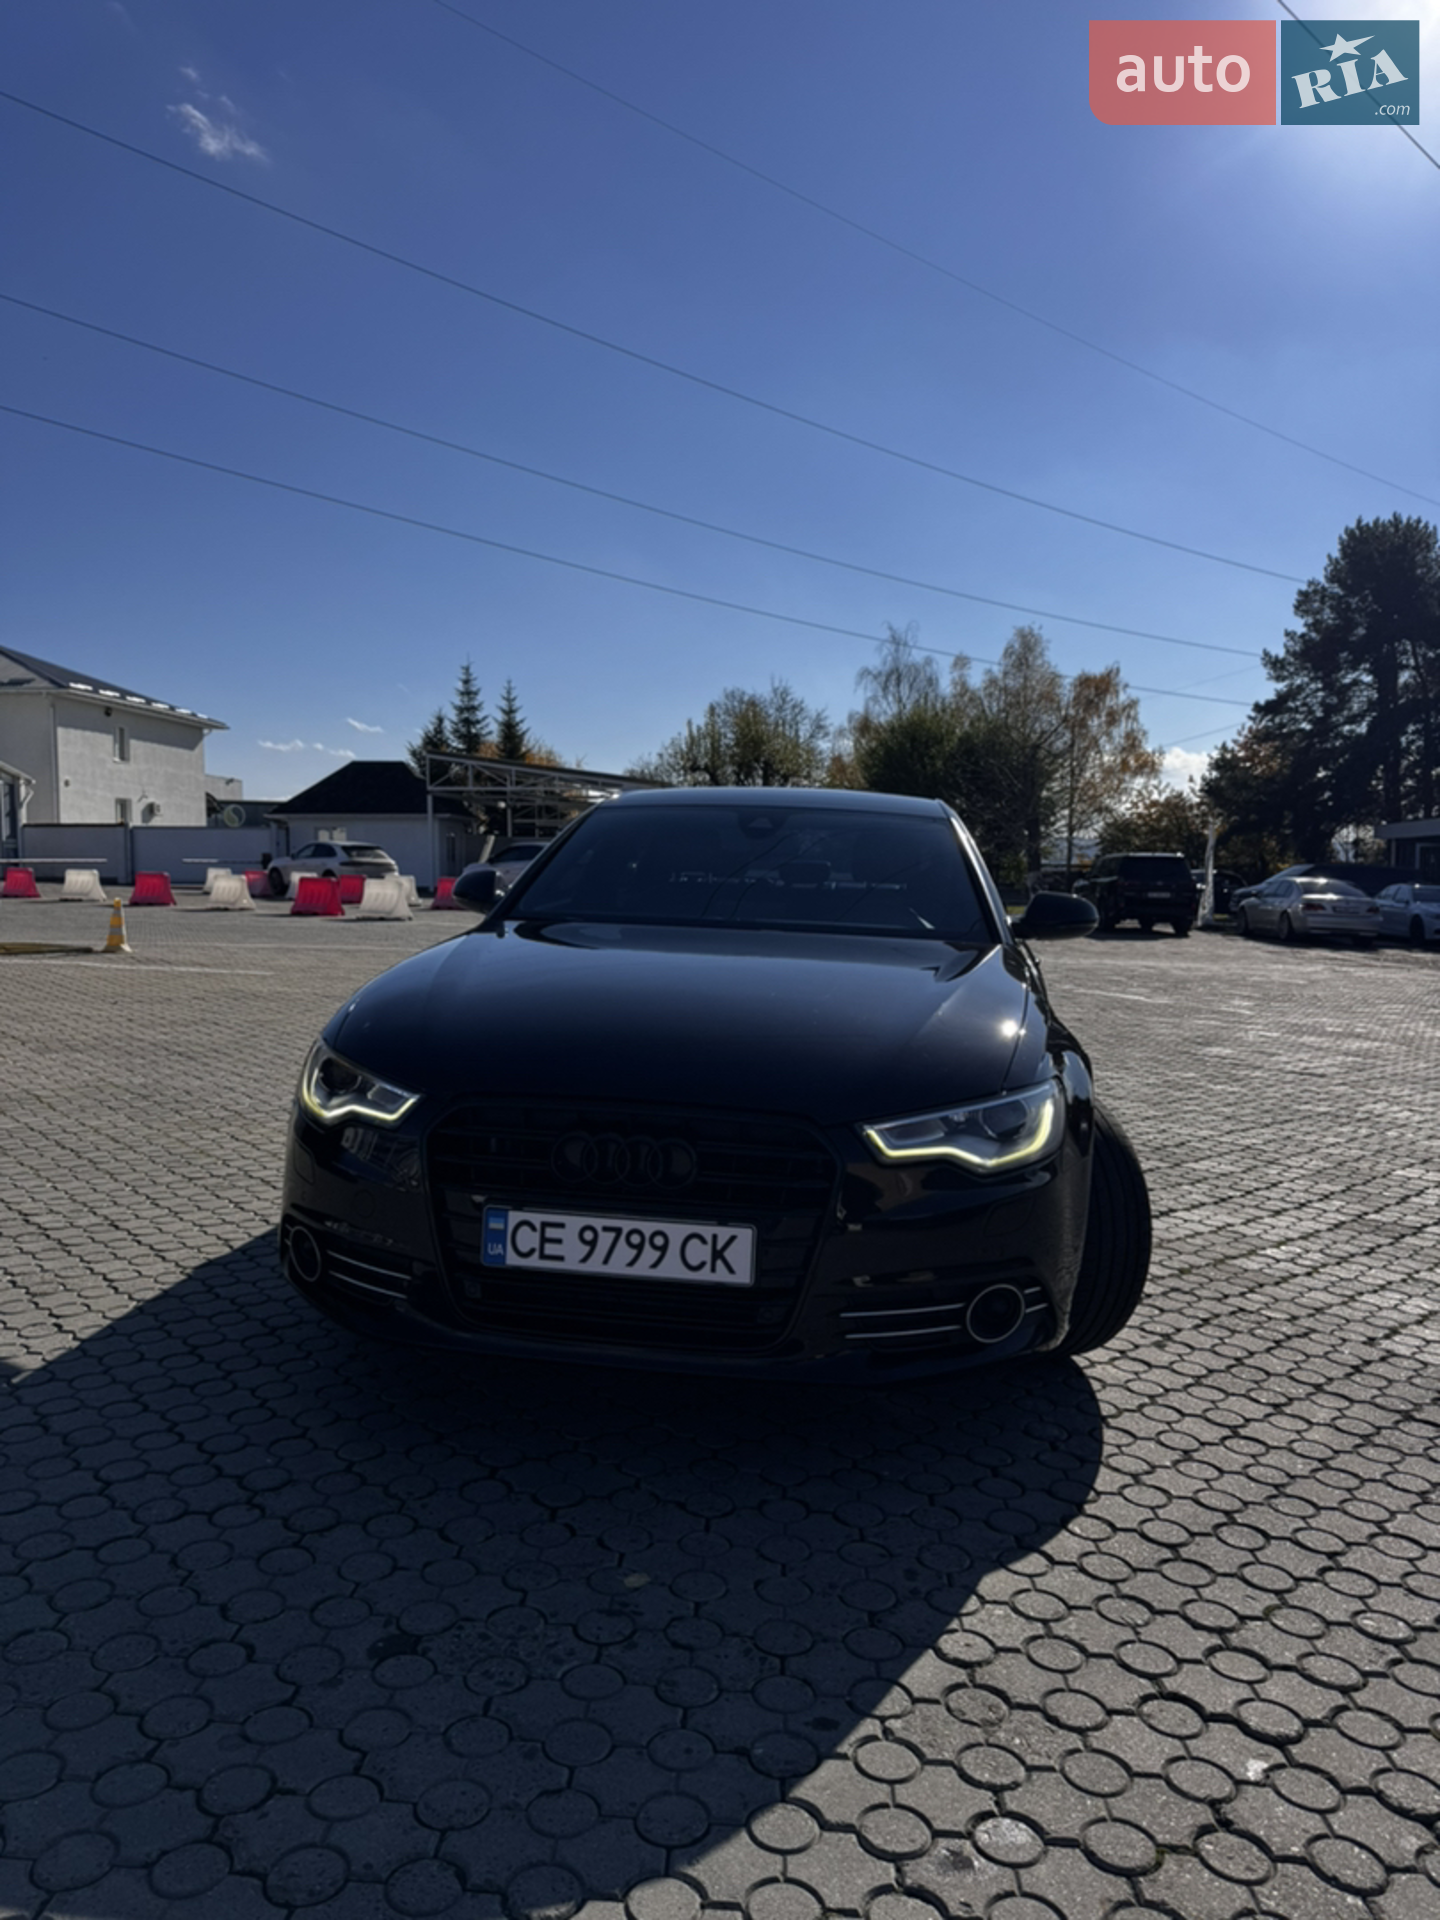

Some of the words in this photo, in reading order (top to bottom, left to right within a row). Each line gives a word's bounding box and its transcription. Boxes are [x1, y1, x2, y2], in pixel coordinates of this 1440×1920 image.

[487, 1242, 504, 1256] UA
[510, 1219, 566, 1262] CE
[577, 1224, 670, 1270] 9799
[679, 1232, 738, 1275] CK
